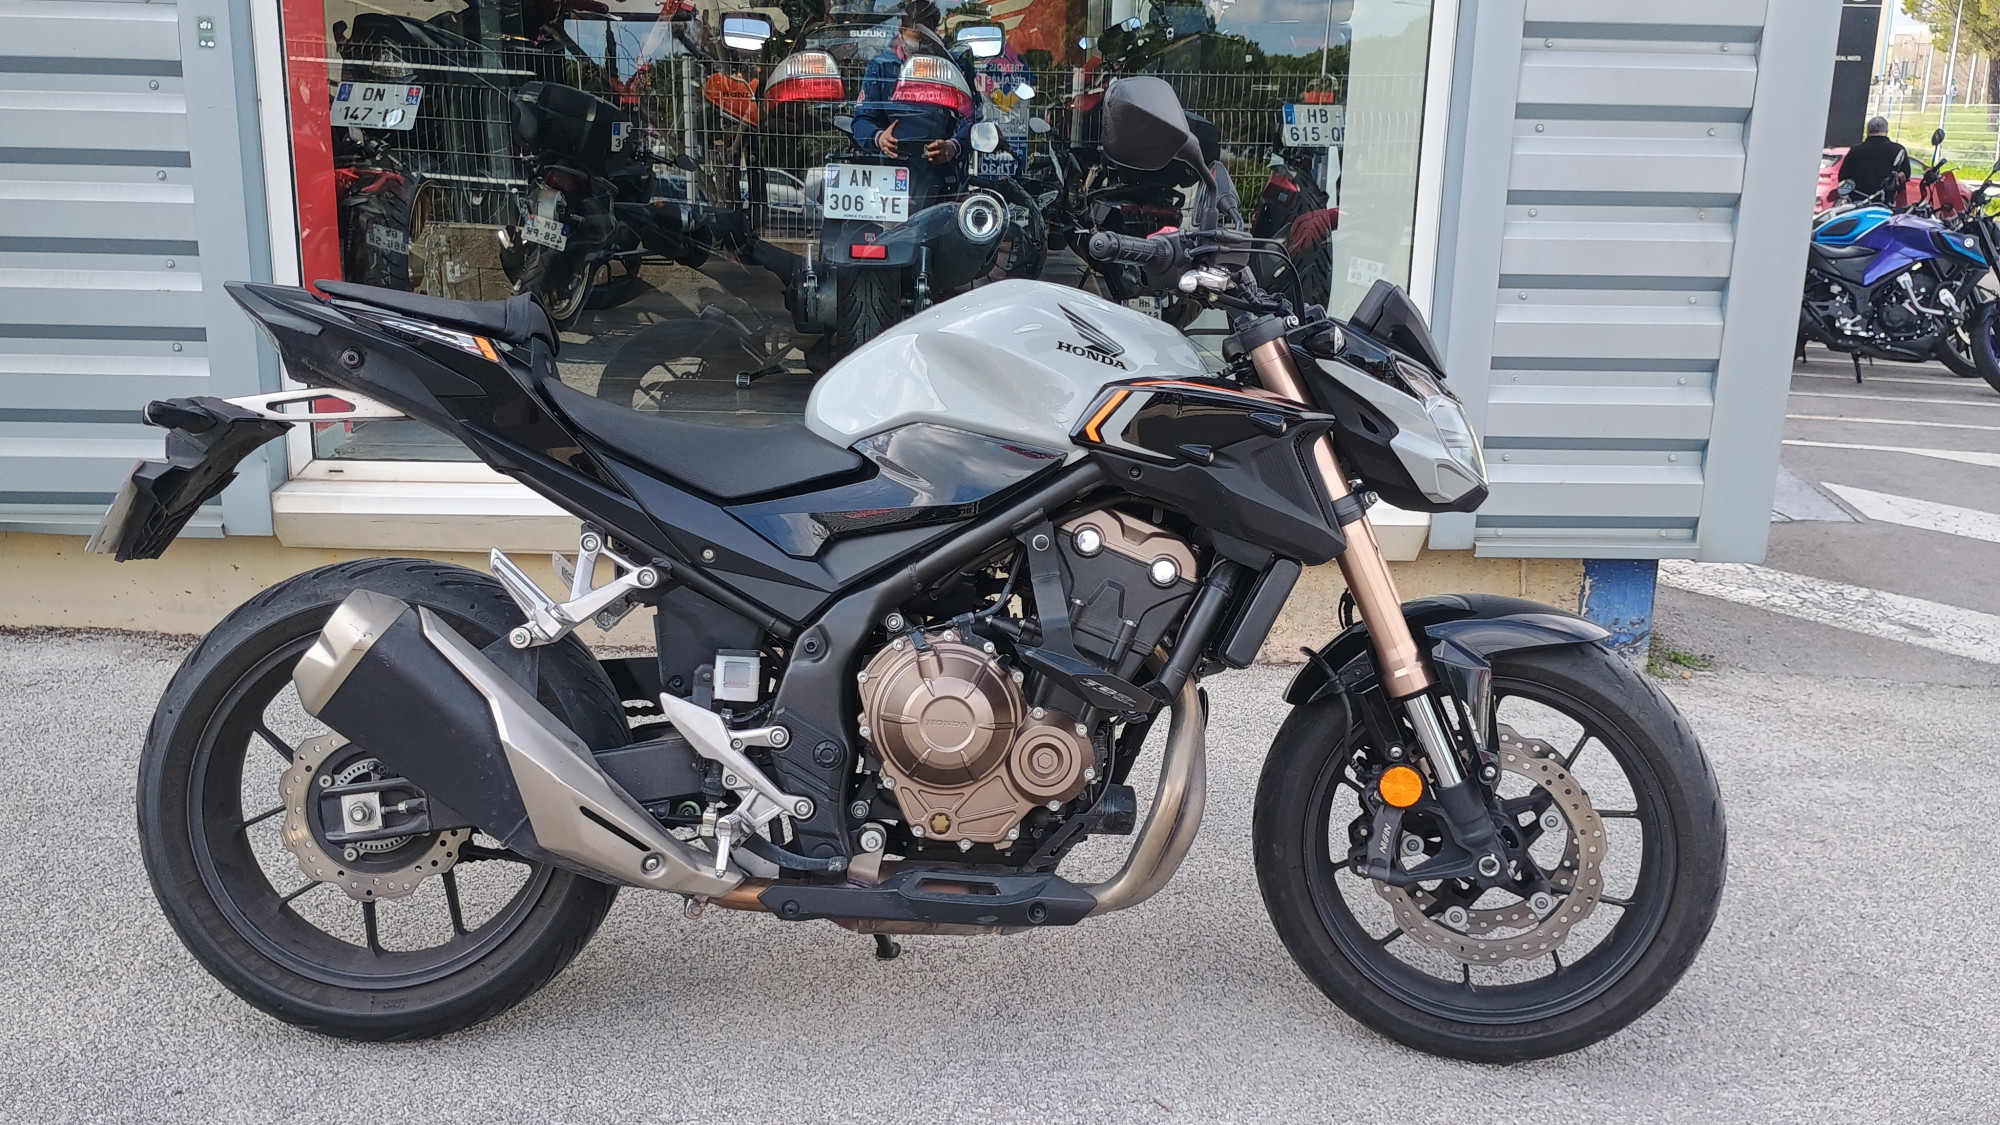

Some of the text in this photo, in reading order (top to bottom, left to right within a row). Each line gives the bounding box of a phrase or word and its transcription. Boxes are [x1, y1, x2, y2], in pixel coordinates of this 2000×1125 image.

[850, 30, 886, 38] SUZUKI
[362, 87, 386, 102] DN
[407, 96, 417, 104] 34
[1307, 108, 1329, 124] HB
[849, 168, 872, 187] AN
[895, 180, 906, 189] 34
[1056, 340, 1129, 372] HONDA
[926, 719, 970, 729] HONDA
[1450, 1022, 1542, 1037] MICHELIN
